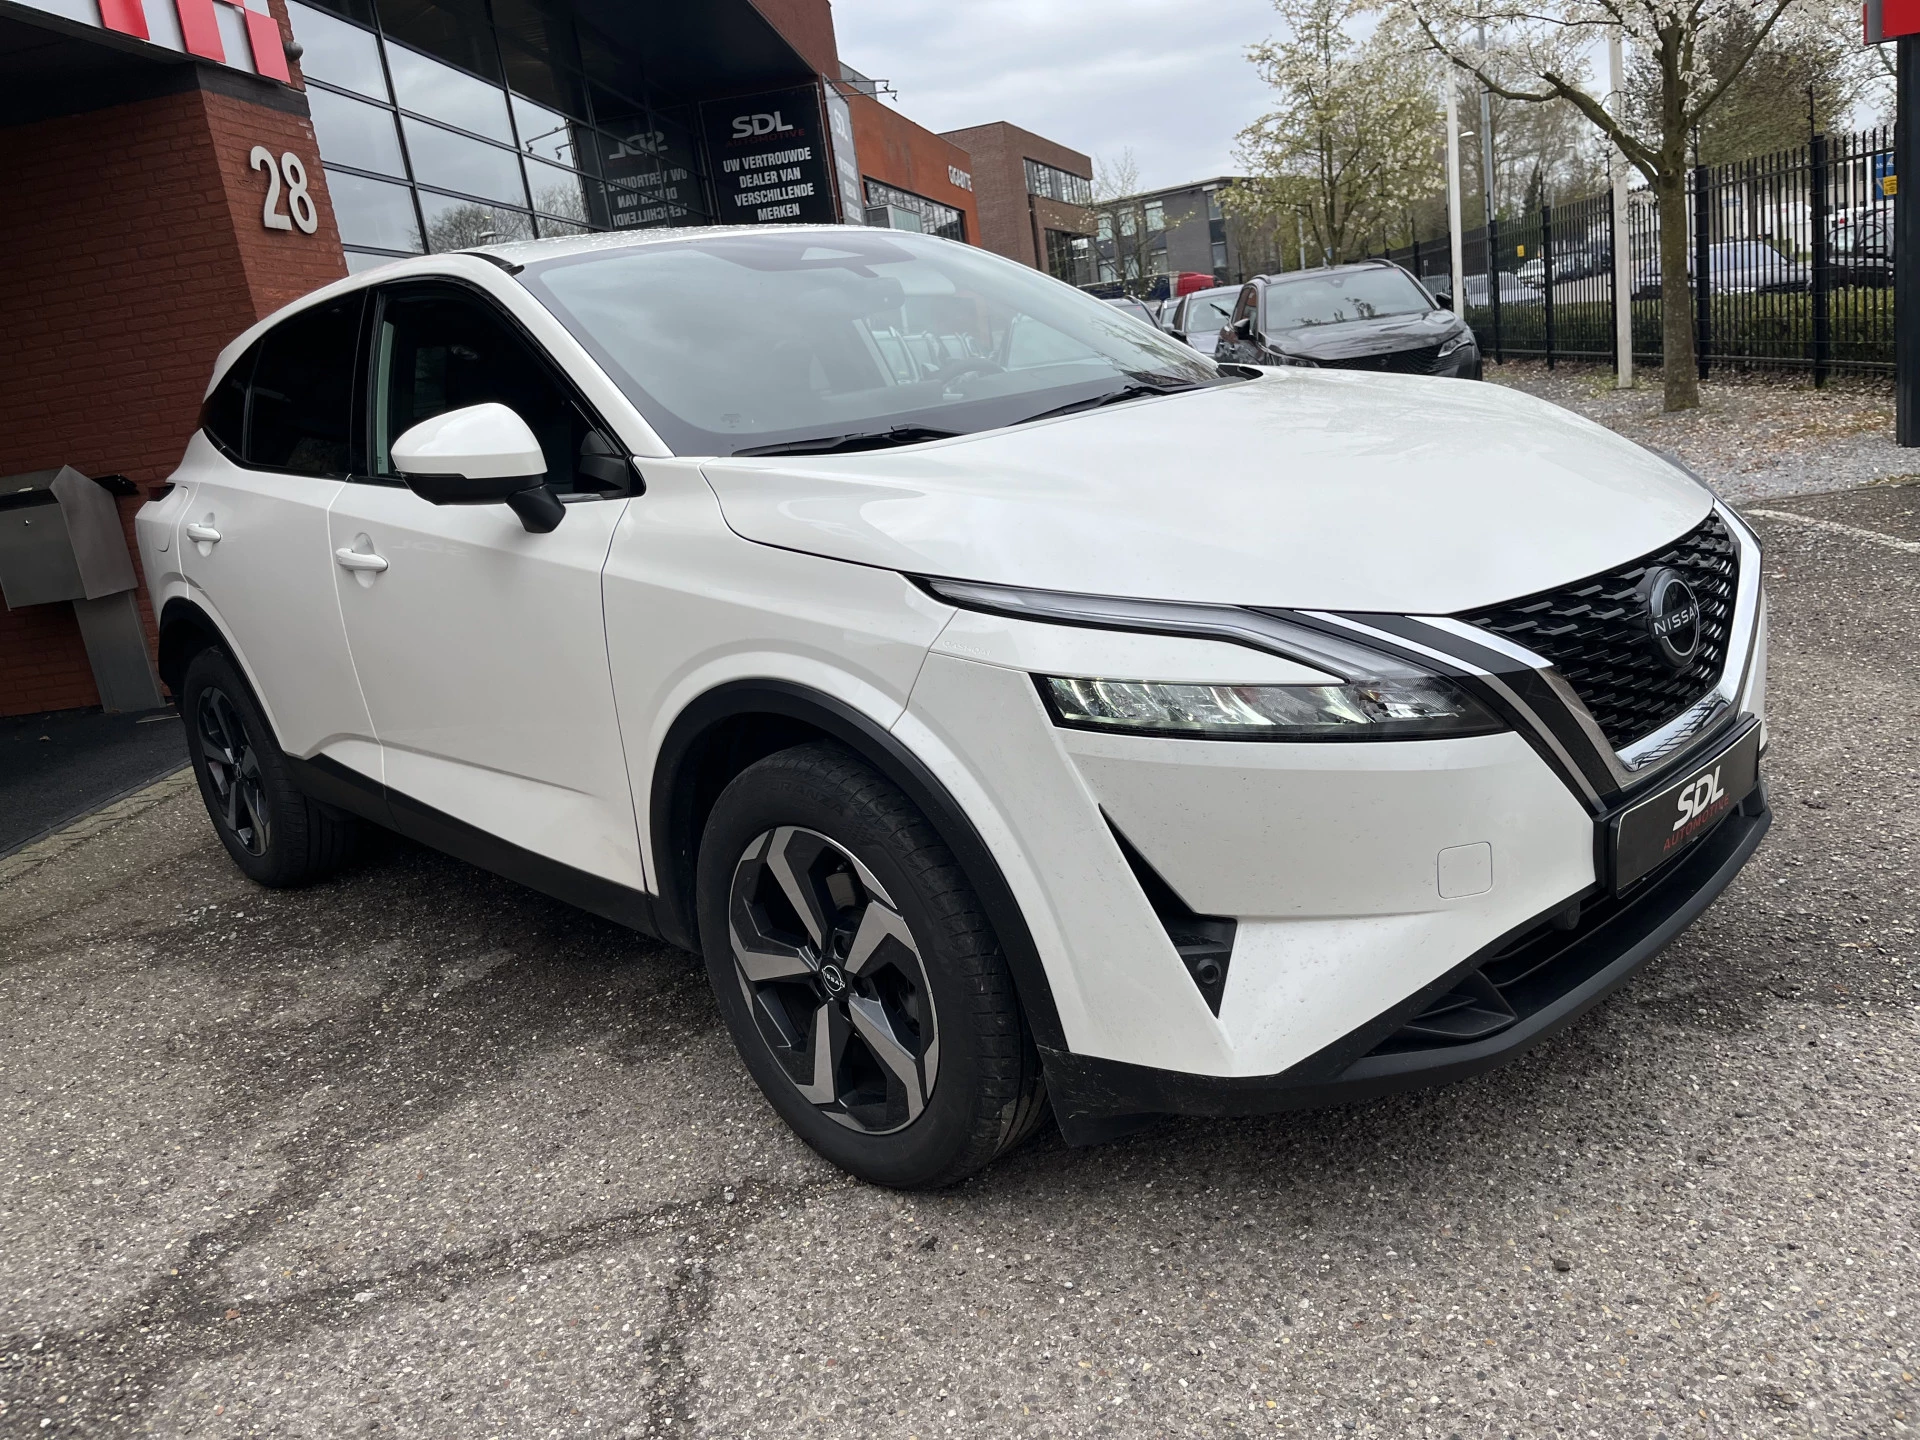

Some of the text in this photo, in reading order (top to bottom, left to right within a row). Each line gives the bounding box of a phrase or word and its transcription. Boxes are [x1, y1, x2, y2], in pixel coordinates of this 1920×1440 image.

[725, 128, 806, 148] AUTOMOTIVE
[731, 111, 794, 139] SDL
[723, 147, 812, 173] UW VERTROUWDE
[250, 145, 318, 235] 28
[739, 166, 801, 188] DEALER VAN
[734, 182, 815, 207] VERSCHILLENDE
[757, 202, 801, 221] MERKEN
[1653, 602, 1699, 635] NISSAN
[1672, 765, 1725, 832] SDL
[1662, 792, 1731, 853] AUTOMOTIVE
